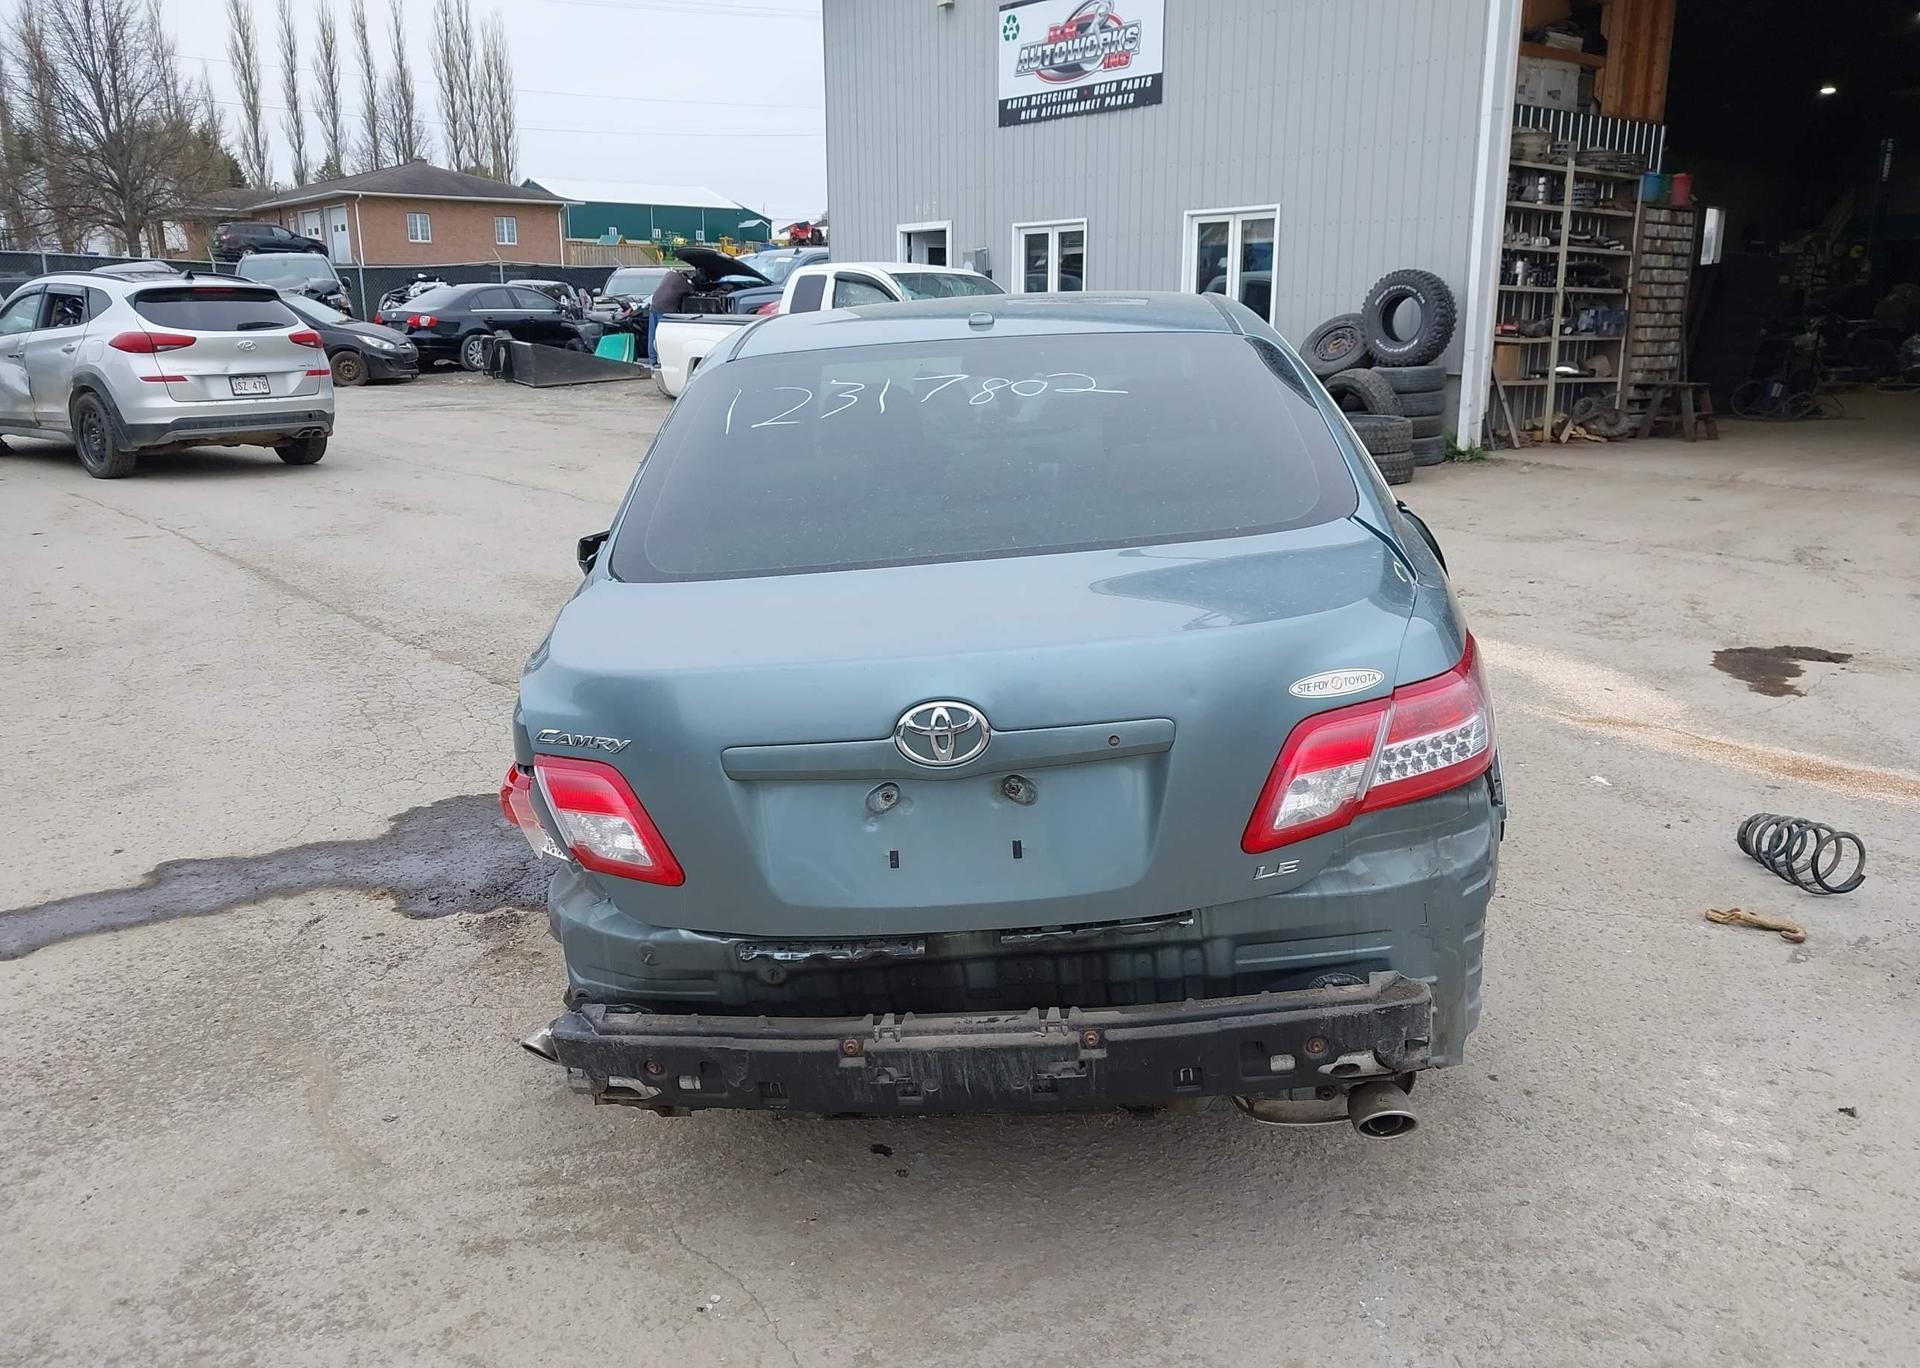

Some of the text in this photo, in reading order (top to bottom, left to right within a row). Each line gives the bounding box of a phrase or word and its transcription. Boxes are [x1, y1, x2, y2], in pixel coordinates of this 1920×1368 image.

[1017, 26, 1139, 71] AUTOWORKS
[1006, 76, 1153, 110] AUTO RECYCLING USED PARTS
[1020, 93, 1135, 120] NEW AFTERMARKET PARTS
[725, 373, 1129, 435] 12317802
[1297, 673, 1377, 693] STE-FOY TOYOTA
[535, 729, 632, 754] CAMRY
[1254, 859, 1300, 880] LE
